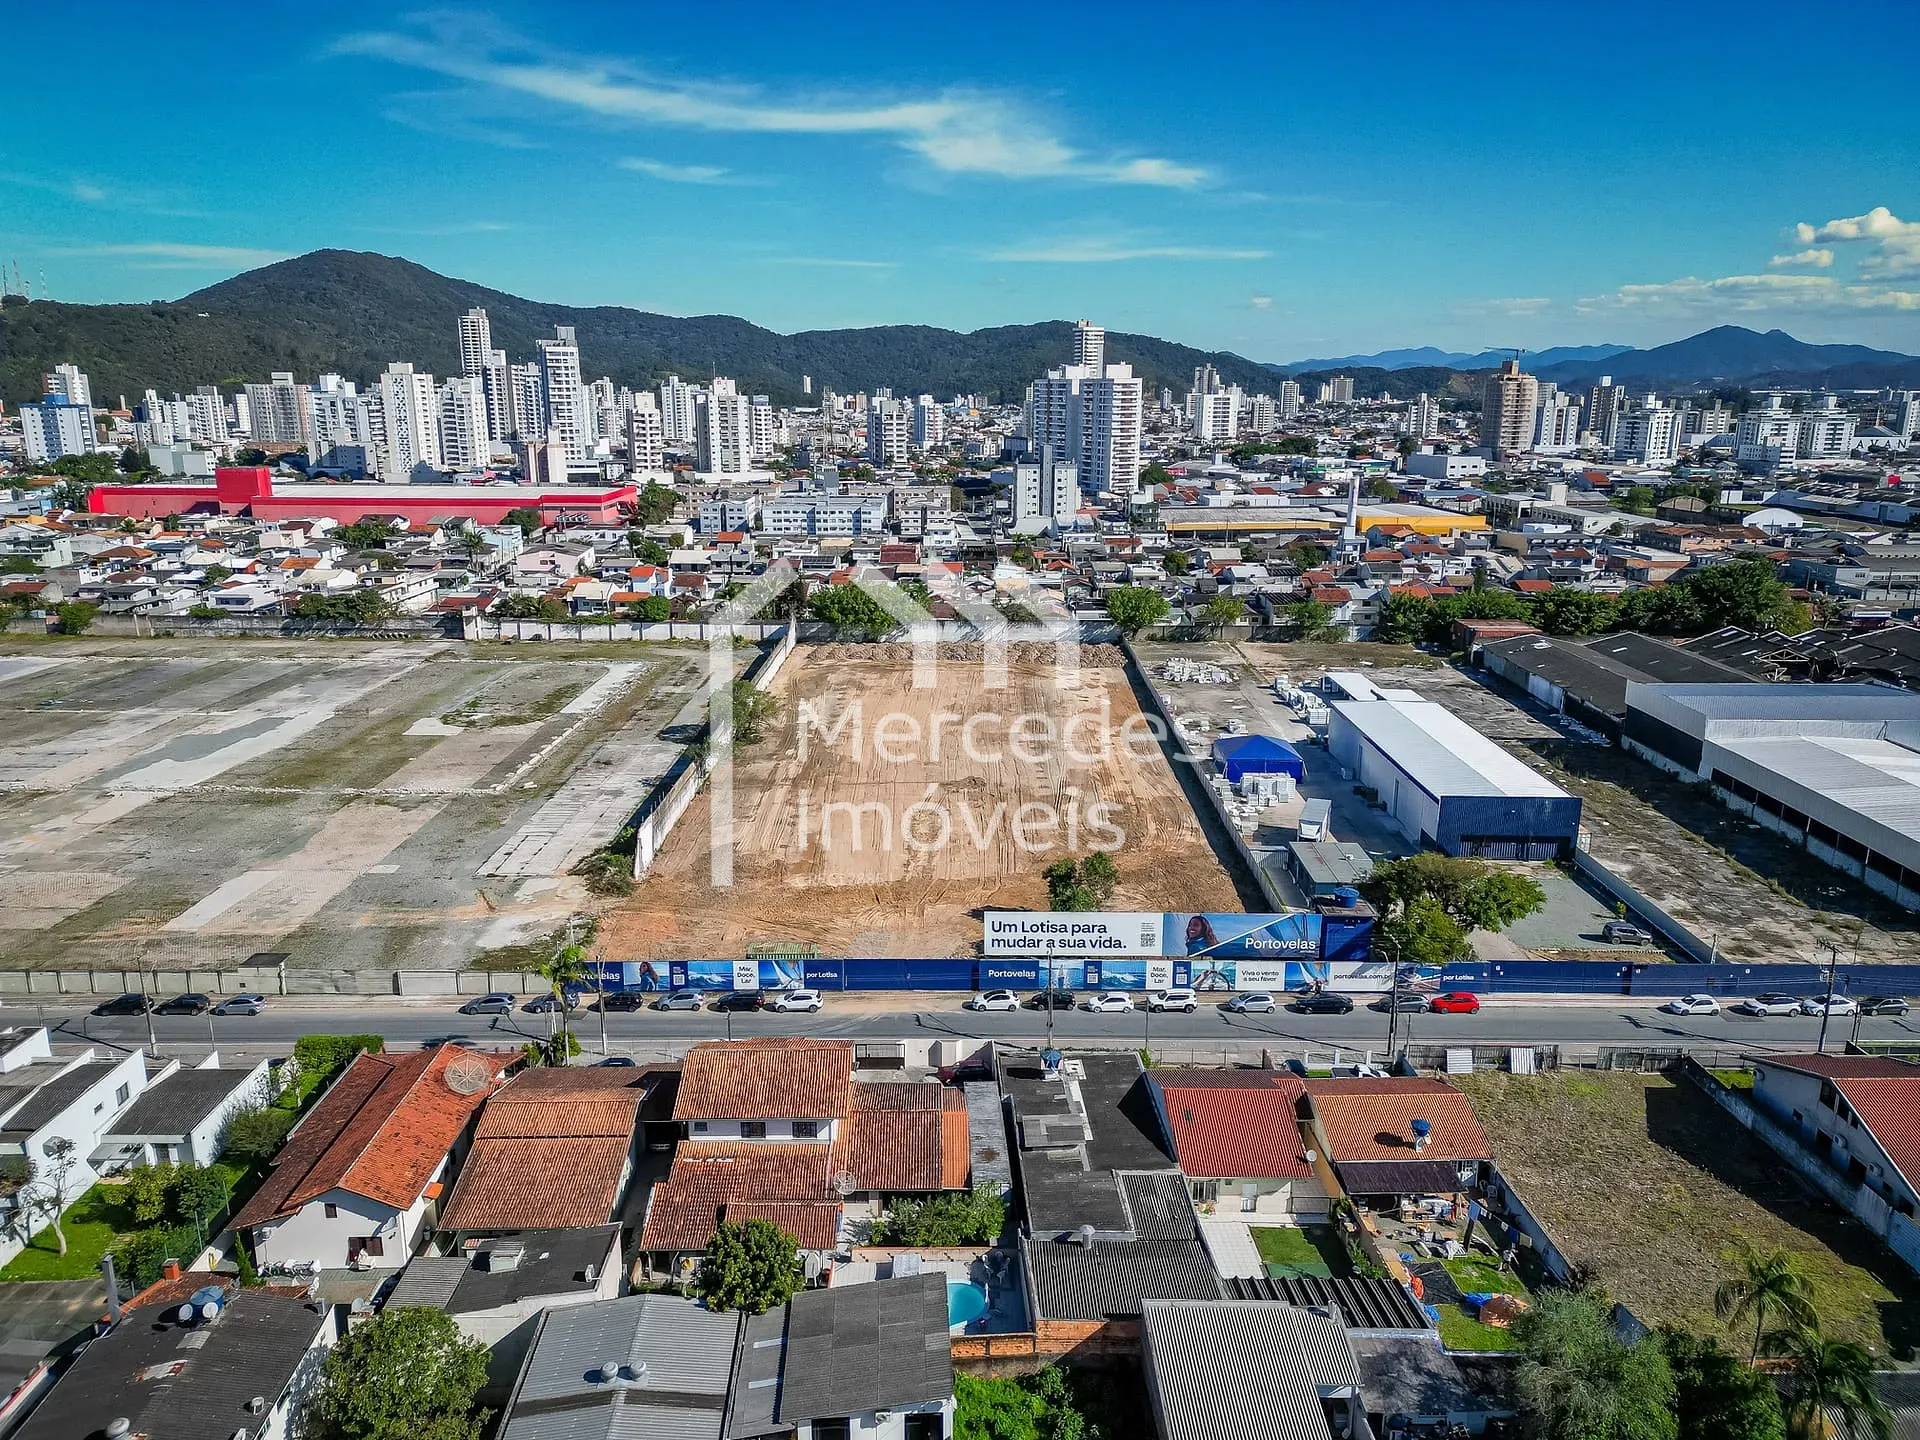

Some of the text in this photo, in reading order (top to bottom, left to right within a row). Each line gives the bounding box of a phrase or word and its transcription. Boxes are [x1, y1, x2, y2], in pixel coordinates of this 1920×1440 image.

[1856, 439, 1907, 449] AVAN
[991, 920, 1107, 936] Um Lotisa para
[991, 936, 1127, 949] mudar a sua vida.
[1245, 937, 1316, 950] Portovelas
[988, 969, 1036, 978] Portovelas
